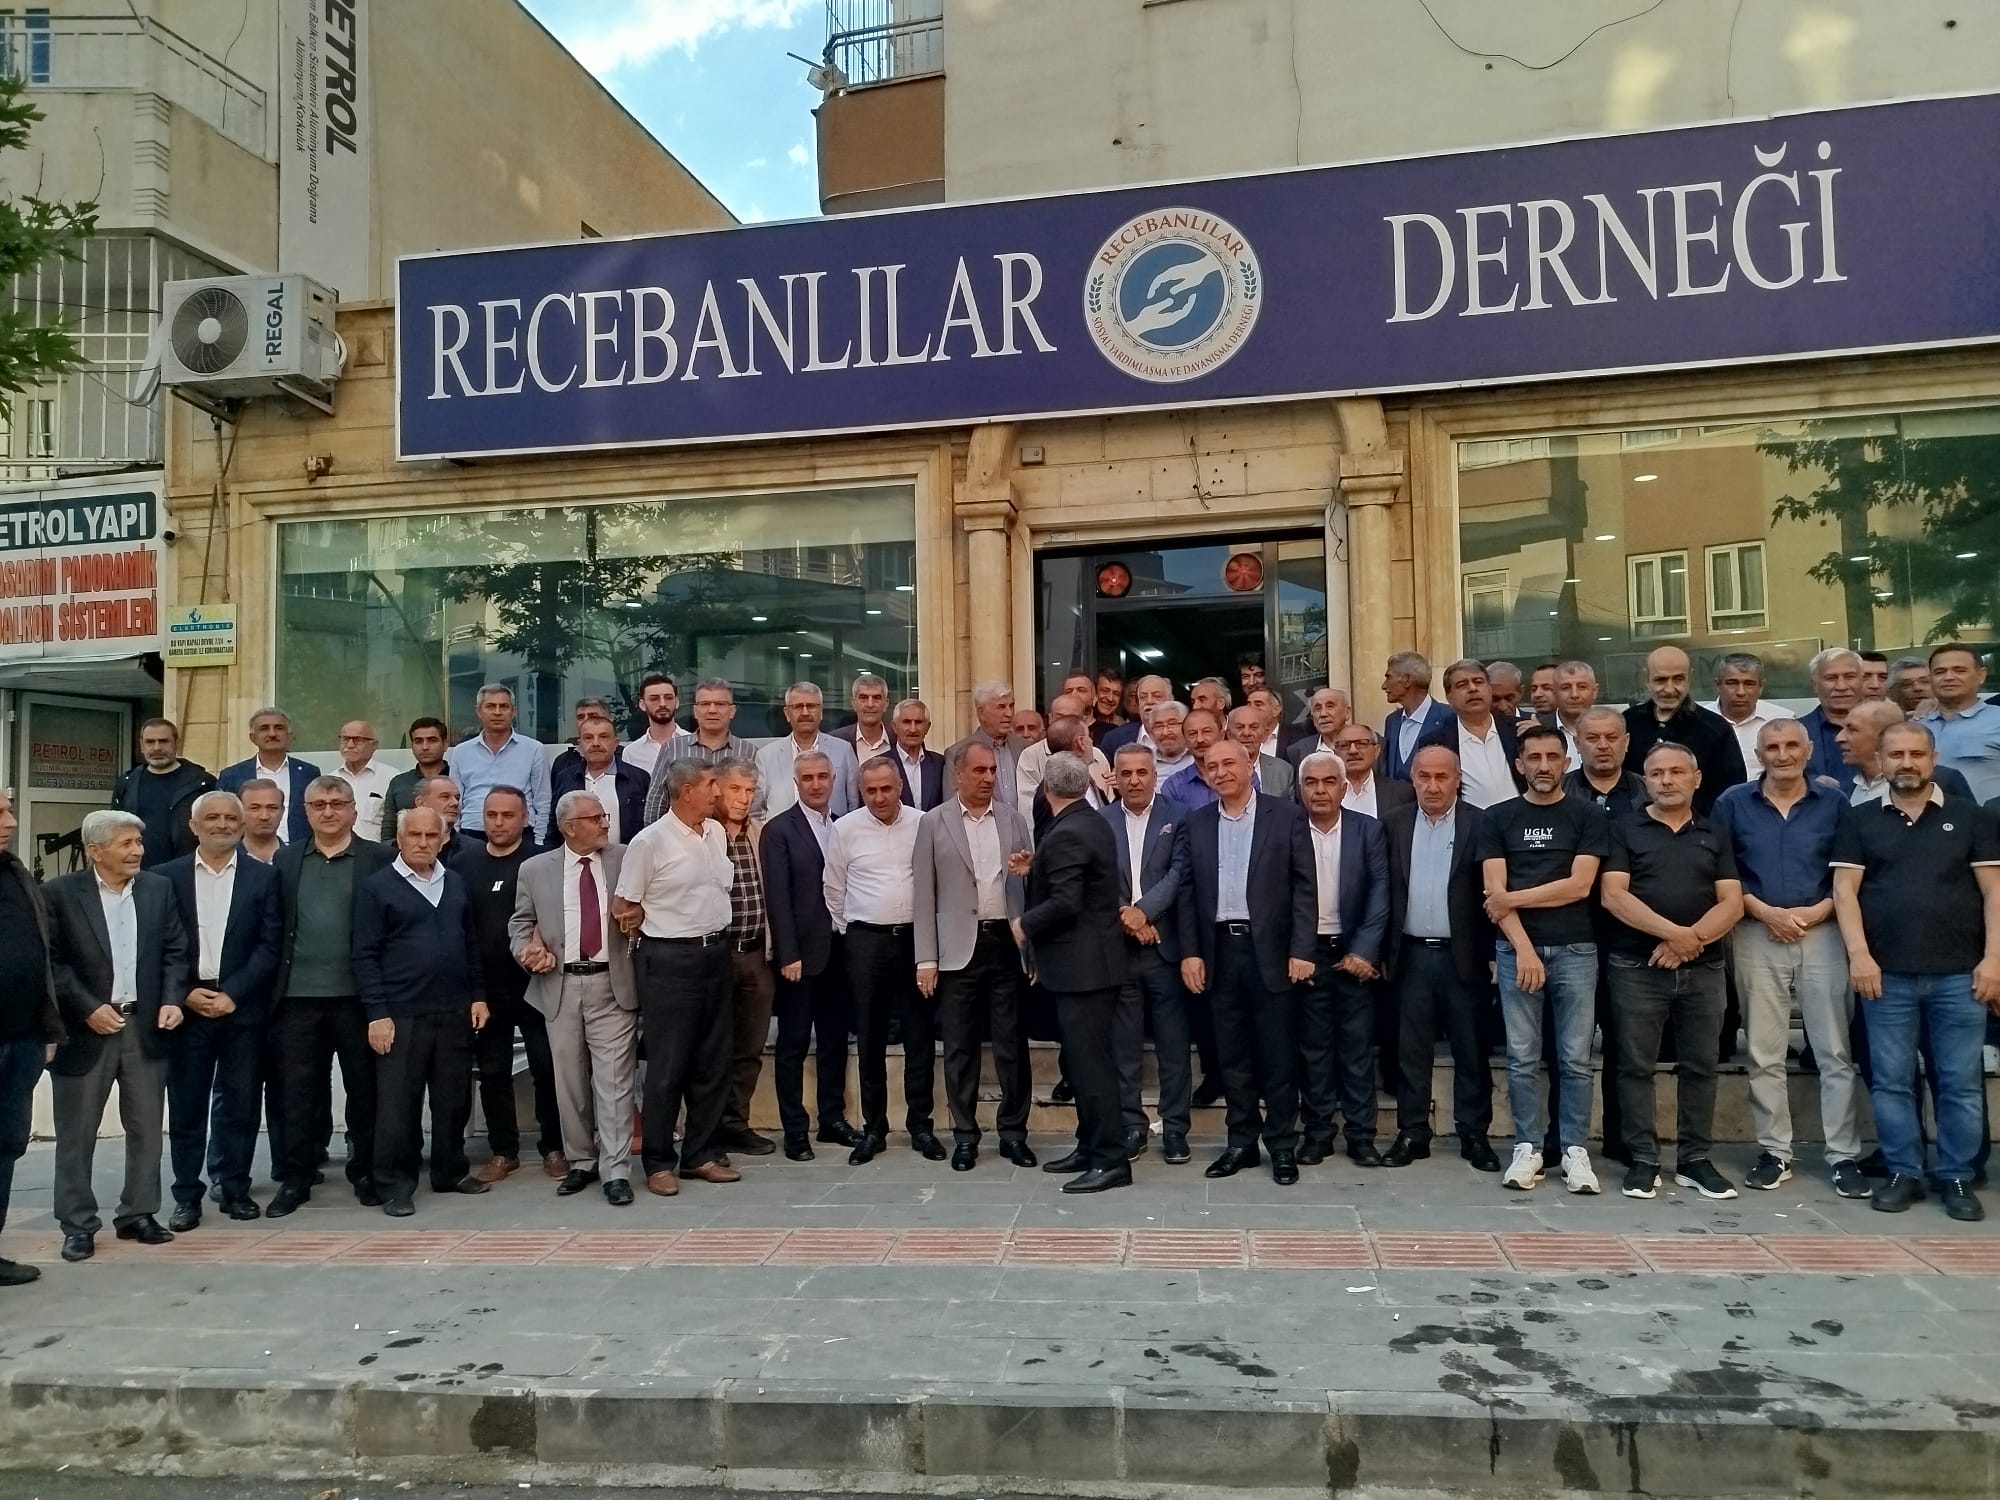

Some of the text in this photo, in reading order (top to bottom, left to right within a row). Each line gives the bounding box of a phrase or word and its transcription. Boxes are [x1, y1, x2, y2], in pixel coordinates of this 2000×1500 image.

[309, 12, 319, 52] Balkon
[309, 53, 319, 110] Sistemleri
[326, 0, 357, 155] ETROL
[296, 101, 305, 153] Korkuluk
[1100, 213, 1244, 266] RECEBANLILAR
[427, 140, 1848, 399] RECEBANLILAR DERNEĞİ
[266, 282, 284, 356] REGAL
[1093, 316, 1111, 348] SOSYAL
[1170, 366, 1182, 376] VE
[61, 543, 158, 595] PANORAMİK
[0, 589, 158, 645] ALKON SİSTEMLERİ
[32, 743, 84, 760] PETROL
[1524, 827, 1553, 835] UGLY
